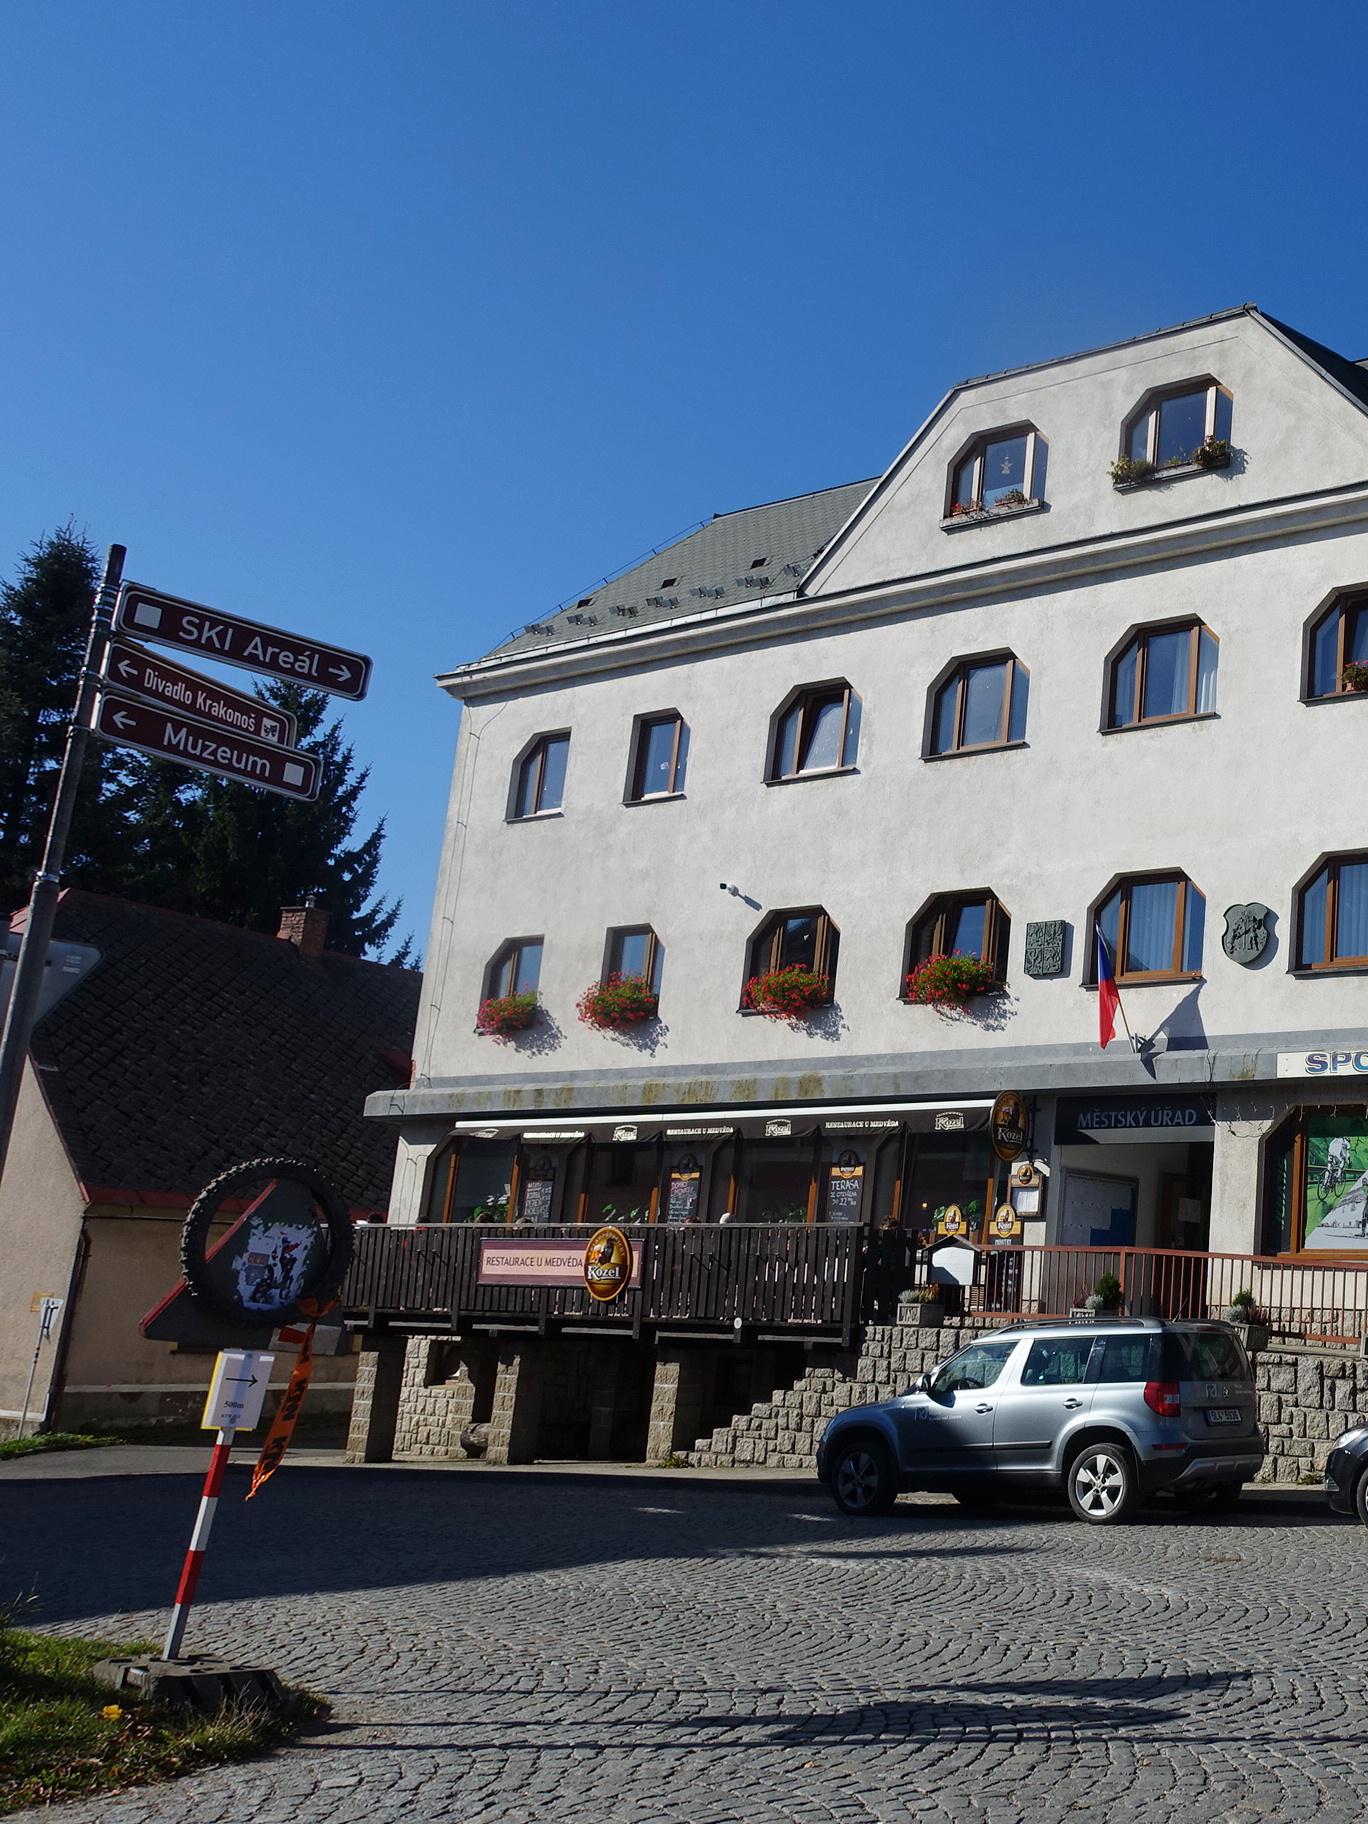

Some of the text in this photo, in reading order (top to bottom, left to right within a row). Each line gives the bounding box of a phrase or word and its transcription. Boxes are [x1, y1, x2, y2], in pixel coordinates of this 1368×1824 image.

[178, 615, 320, 678] SKI Areál
[143, 667, 257, 732] Divadlo Krakonoš
[161, 722, 272, 778] Muzeum
[935, 1117, 965, 1130] Kozel
[1077, 1106, 1197, 1128] MĚSTSKÝ ÚŘAD
[765, 1124, 792, 1136] Kozel
[825, 1121, 864, 1129] RESTAURACE
[997, 1126, 1024, 1144] Kozel
[831, 1180, 859, 1191] TERASA
[486, 1256, 536, 1267] RESTAURACE
[536, 1257, 542, 1267] U
[588, 1265, 622, 1280] Kozel
